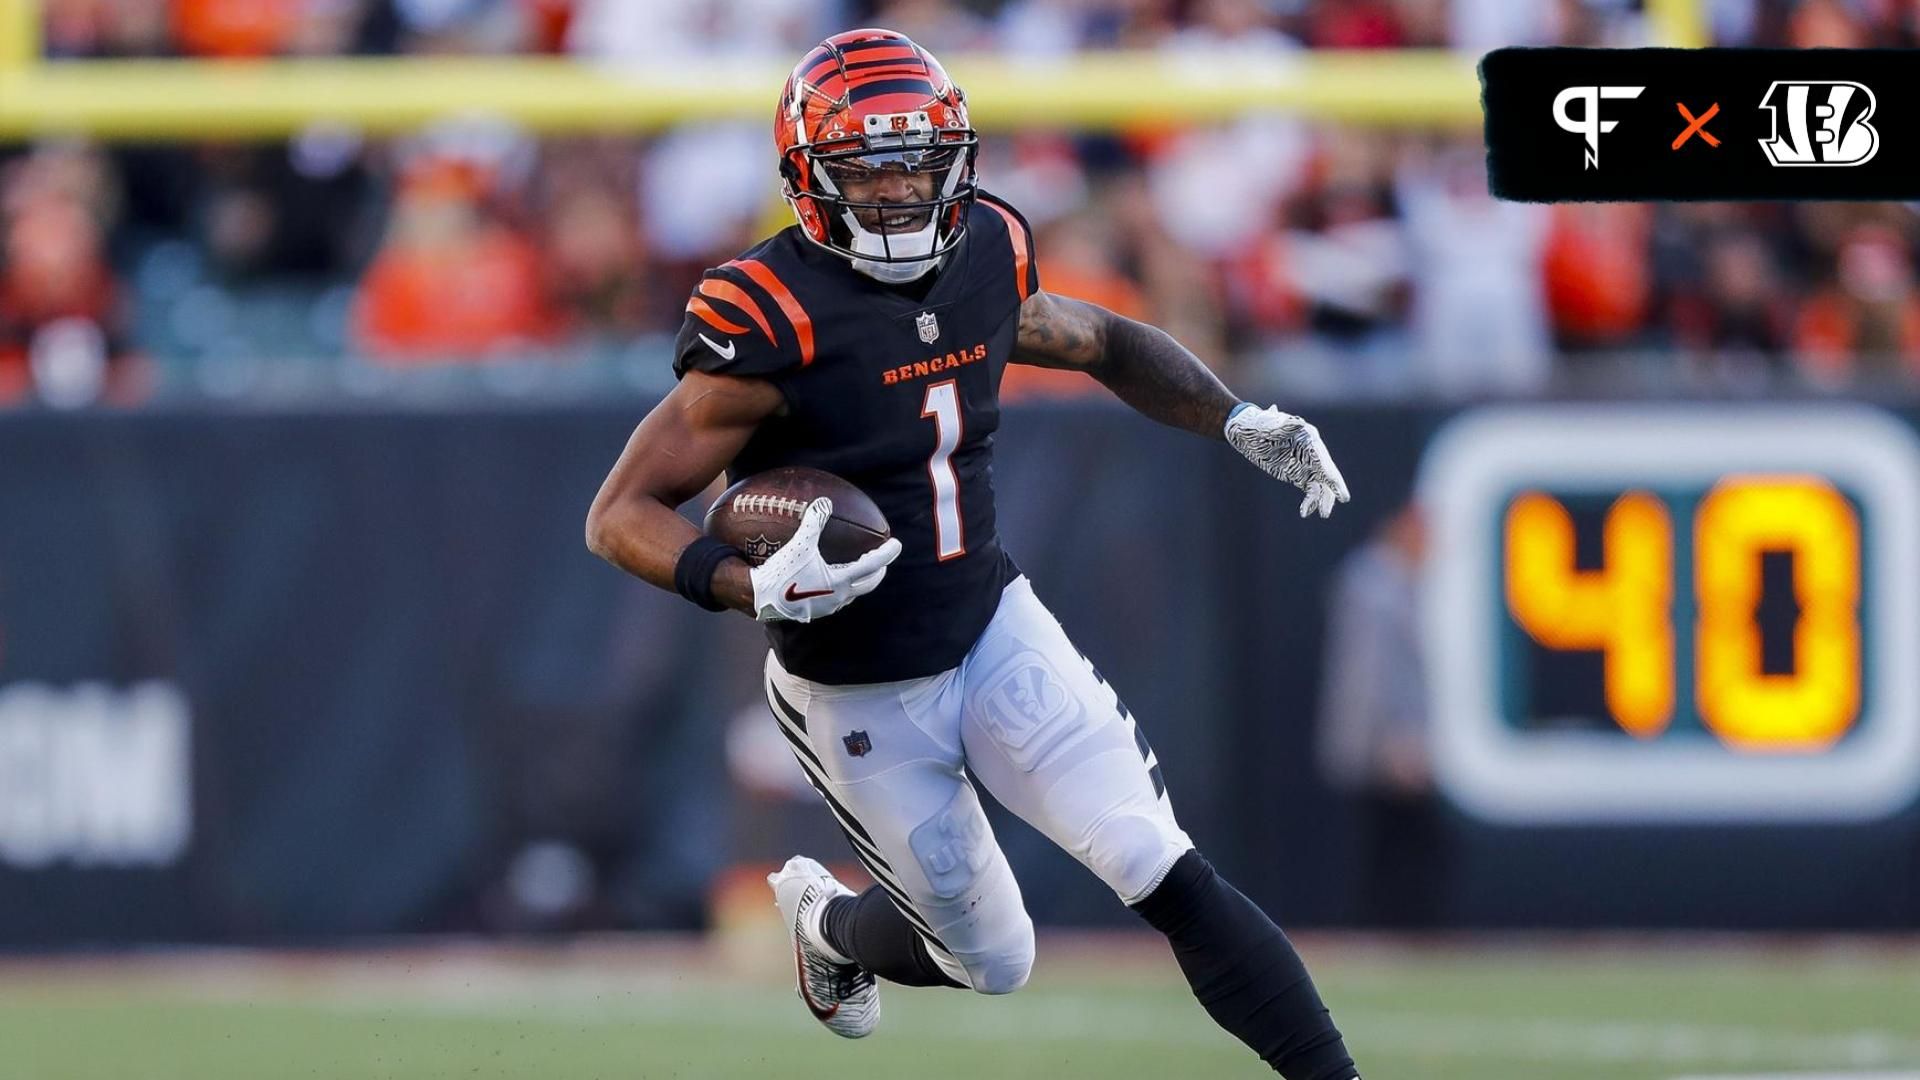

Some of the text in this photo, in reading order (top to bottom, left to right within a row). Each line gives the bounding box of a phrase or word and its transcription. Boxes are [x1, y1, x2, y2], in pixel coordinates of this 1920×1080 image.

[883, 344, 987, 385] BENGALS
[920, 378, 966, 561] 1
[1504, 474, 1862, 754] 40
